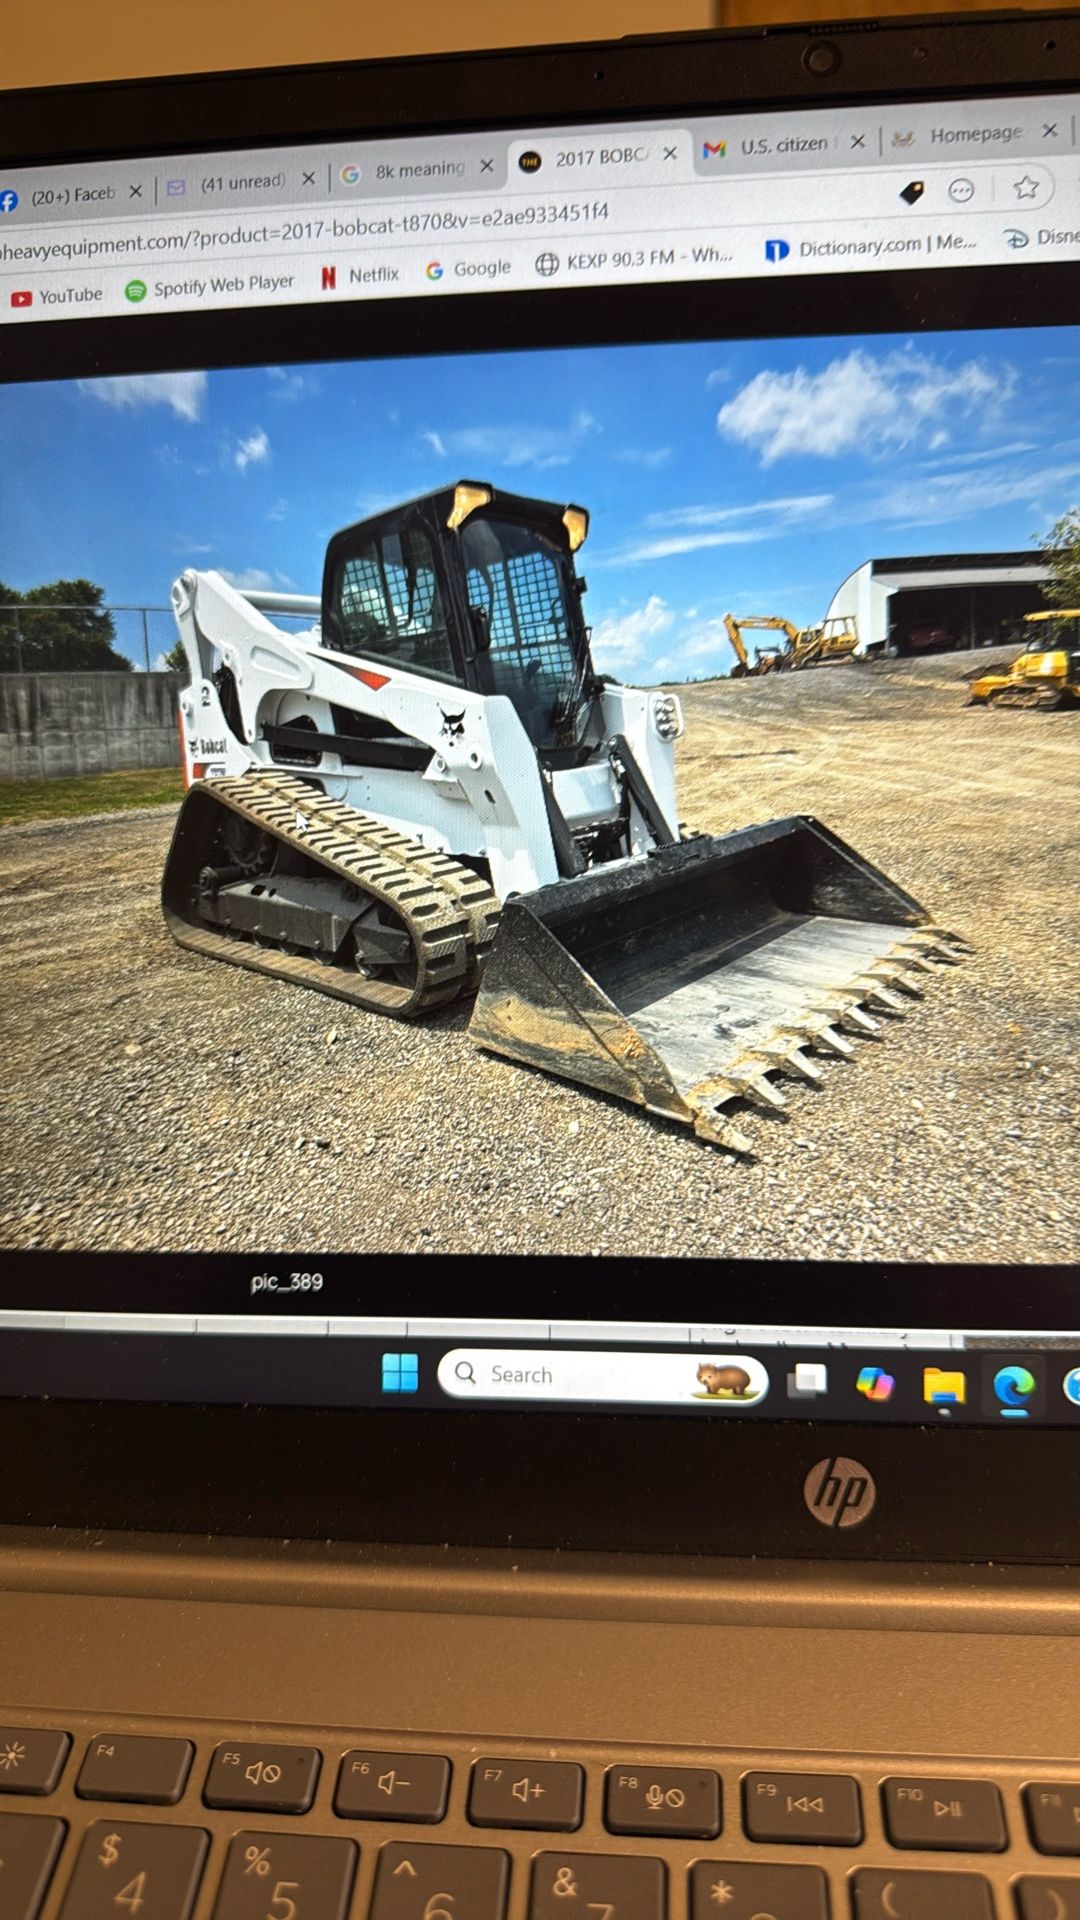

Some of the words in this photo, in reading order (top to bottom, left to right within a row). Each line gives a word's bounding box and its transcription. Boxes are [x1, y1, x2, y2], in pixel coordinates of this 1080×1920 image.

[930, 124, 1023, 143] Homepage
[741, 138, 772, 156] U.S.
[776, 136, 829, 153] citizen
[376, 163, 395, 180] 8k
[399, 159, 466, 180] meaning
[556, 150, 595, 168] 2017
[201, 174, 224, 194] (41
[228, 172, 286, 192] unread)
[31, 189, 71, 208] (20+)
[0, 202, 610, 263] heavyequipment.com/?product=2017-bobcat-t870&v=e2ae933451f4
[799, 239, 921, 259] Dictionary.com
[936, 233, 977, 251] Me...
[567, 254, 606, 271] KEXP
[612, 252, 645, 268] 90.3
[650, 249, 674, 265] FM
[691, 244, 733, 263] Wh...
[349, 266, 400, 284] Netflix
[454, 259, 512, 280] Google
[39, 285, 104, 305] YouTube
[154, 279, 207, 301] Spotify
[211, 276, 244, 295] Web
[249, 272, 295, 293] Player
[251, 1270, 324, 1296] pic_389
[491, 1362, 553, 1386] Search
[813, 1456, 868, 1528] hp
[96, 1743, 115, 1758] F4
[222, 1752, 241, 1766] F5
[352, 1762, 371, 1776] F6
[483, 1769, 503, 1783] F7
[619, 1776, 639, 1790] F8
[757, 1783, 777, 1797] F9
[897, 1788, 923, 1801] F10
[98, 1833, 122, 1867] $
[244, 1846, 271, 1876] %
[552, 1867, 578, 1897] &
[113, 1871, 147, 1915] 4
[266, 1881, 301, 1920] 5
